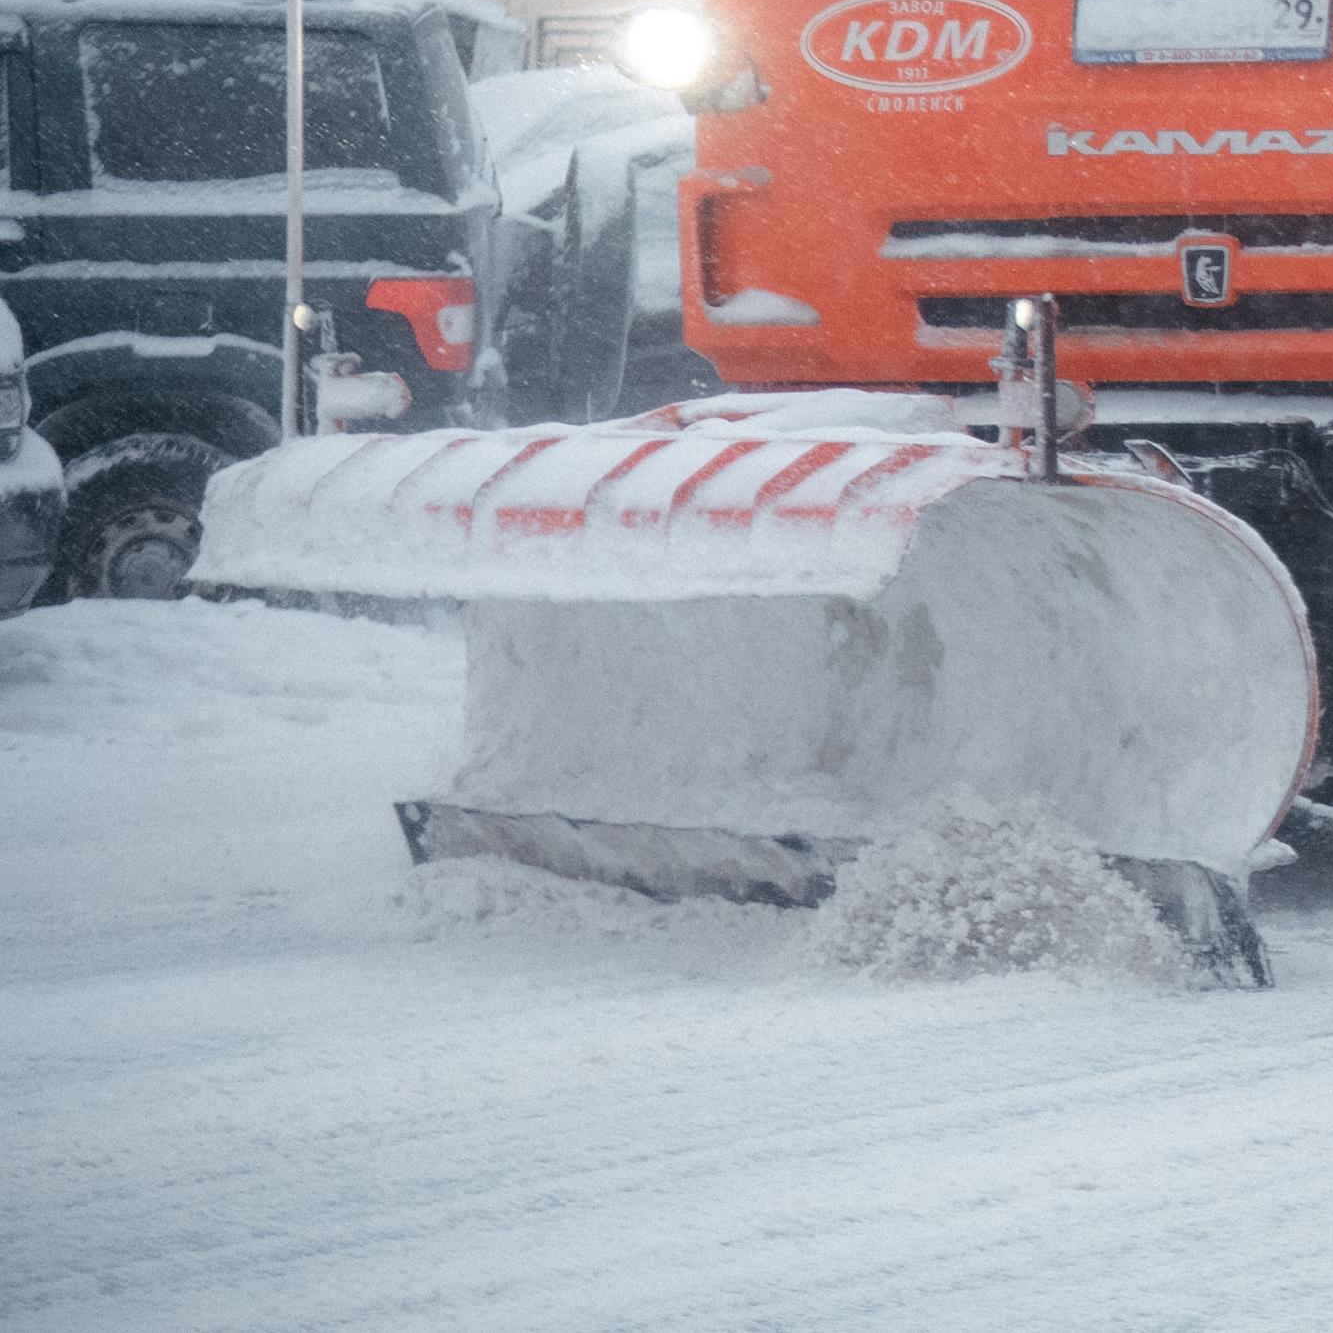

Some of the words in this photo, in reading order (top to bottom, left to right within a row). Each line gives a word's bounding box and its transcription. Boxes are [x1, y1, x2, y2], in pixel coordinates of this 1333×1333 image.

[888, 1, 945, 14] ЗАВОД
[840, 19, 991, 61] KDM
[866, 96, 964, 112] СМОЛЕНСК
